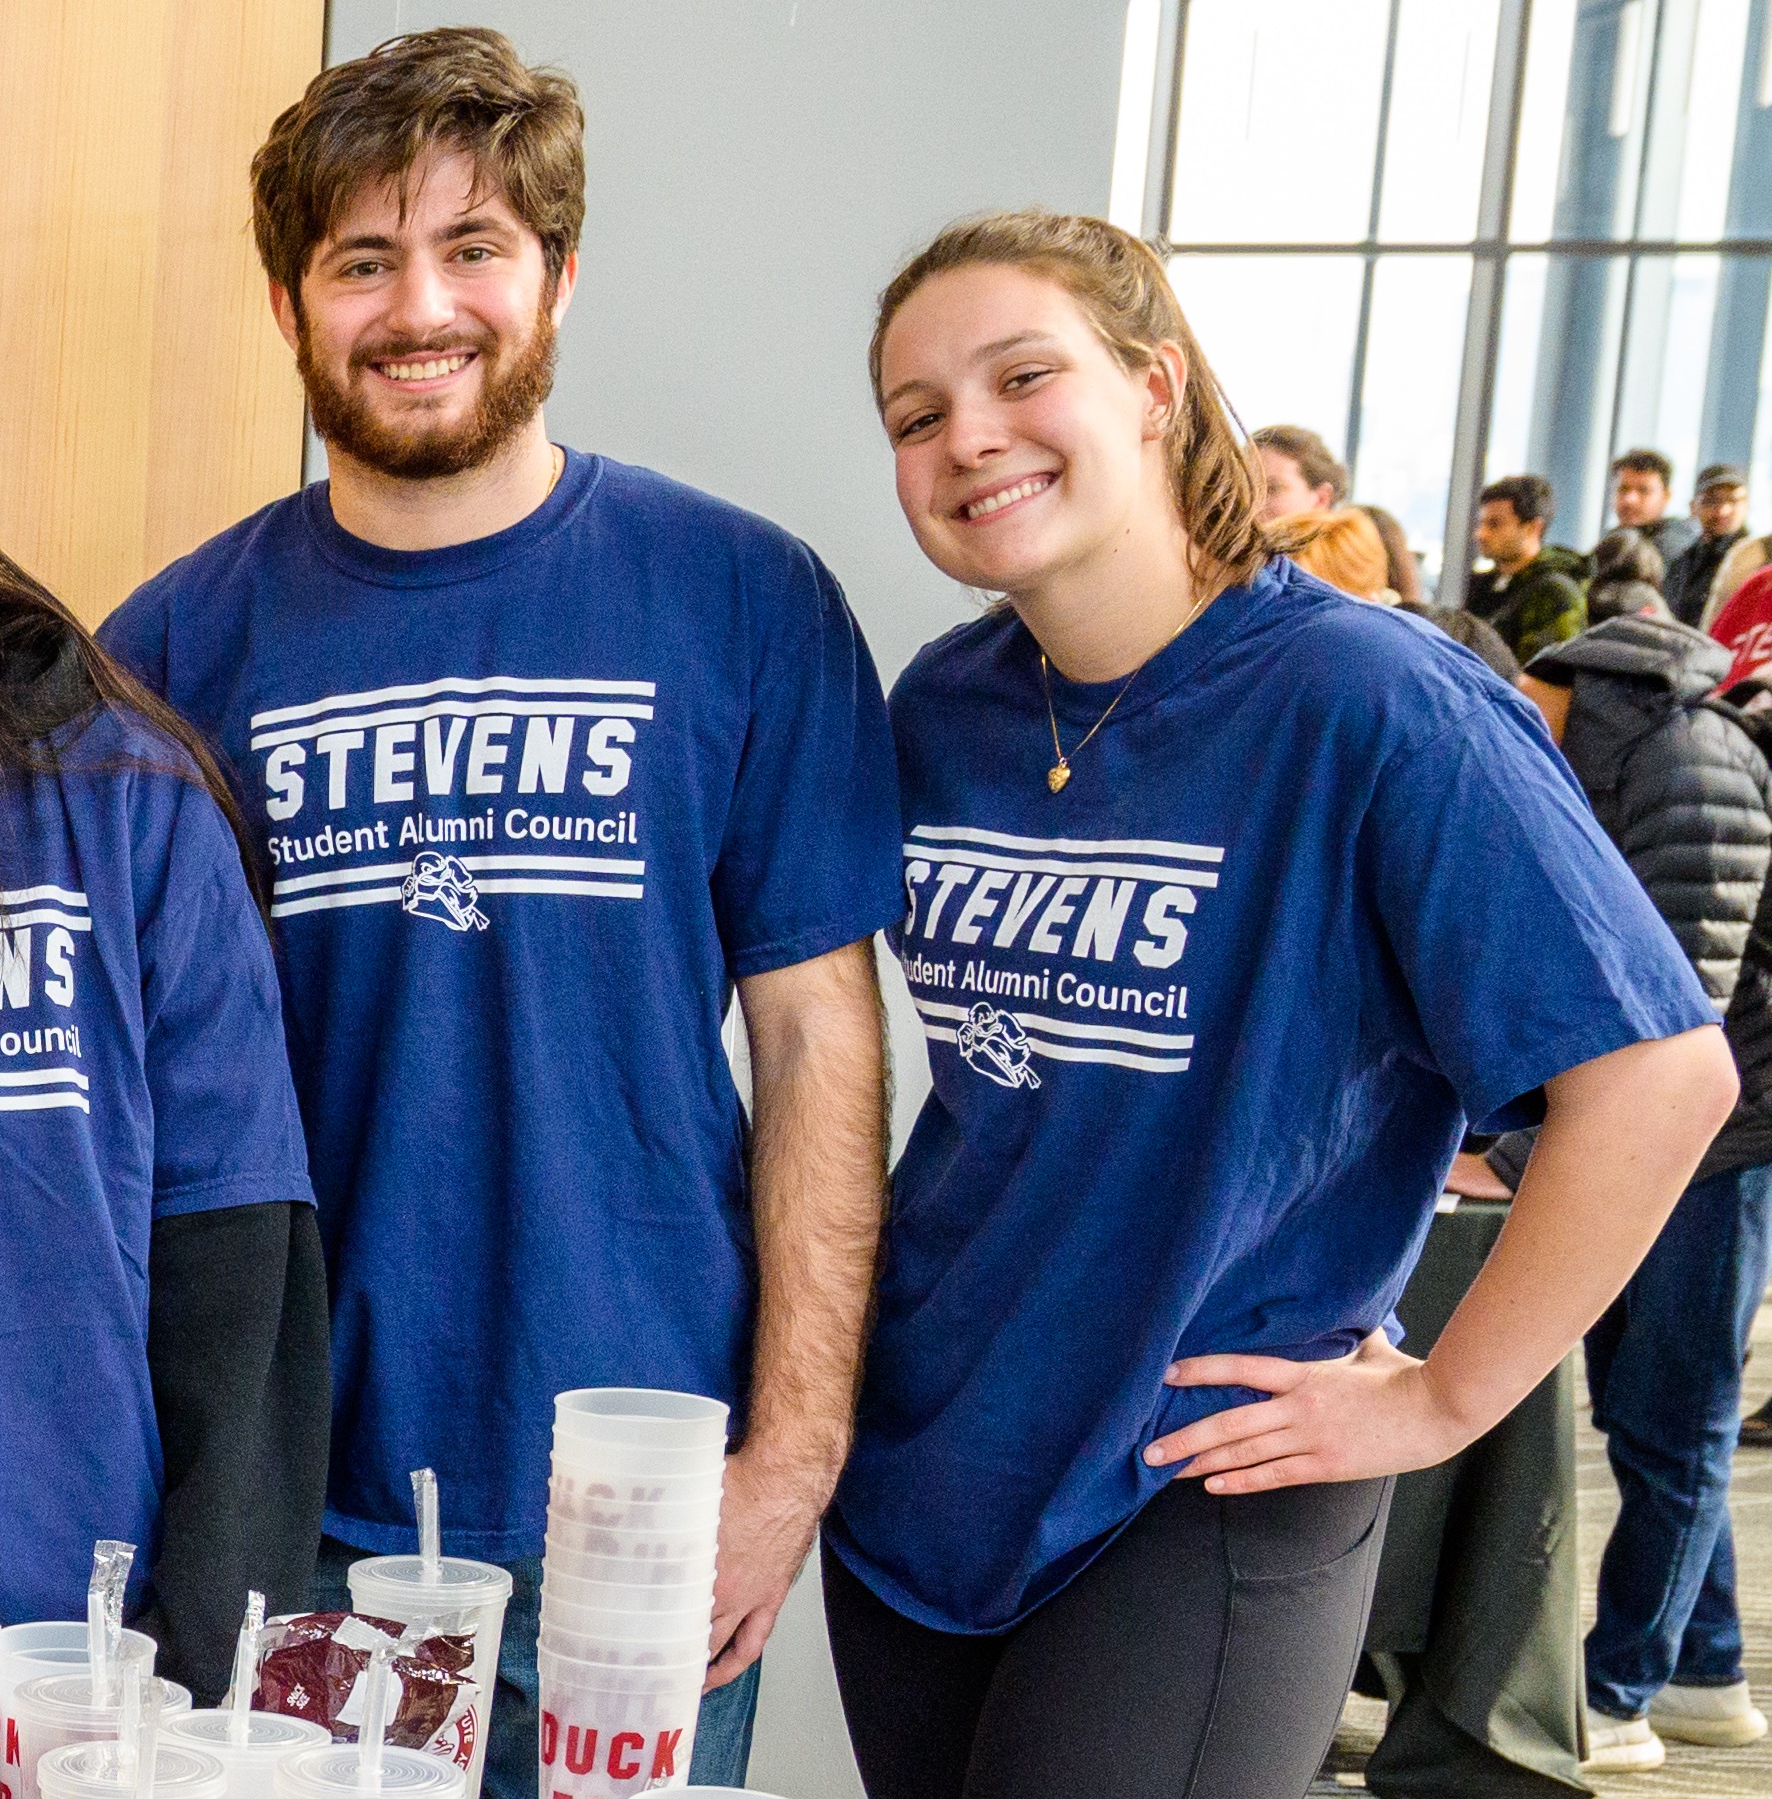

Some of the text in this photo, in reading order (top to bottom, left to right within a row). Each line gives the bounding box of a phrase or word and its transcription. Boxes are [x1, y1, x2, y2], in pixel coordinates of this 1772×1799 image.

[265, 715, 637, 821] STEVENS
[268, 808, 637, 866] Student Alumni Council
[905, 859, 1197, 969] STEVENS
[960, 959, 1050, 1000] Alumni
[1056, 973, 1188, 1019] Council
[542, 1709, 683, 1779] DUCK
